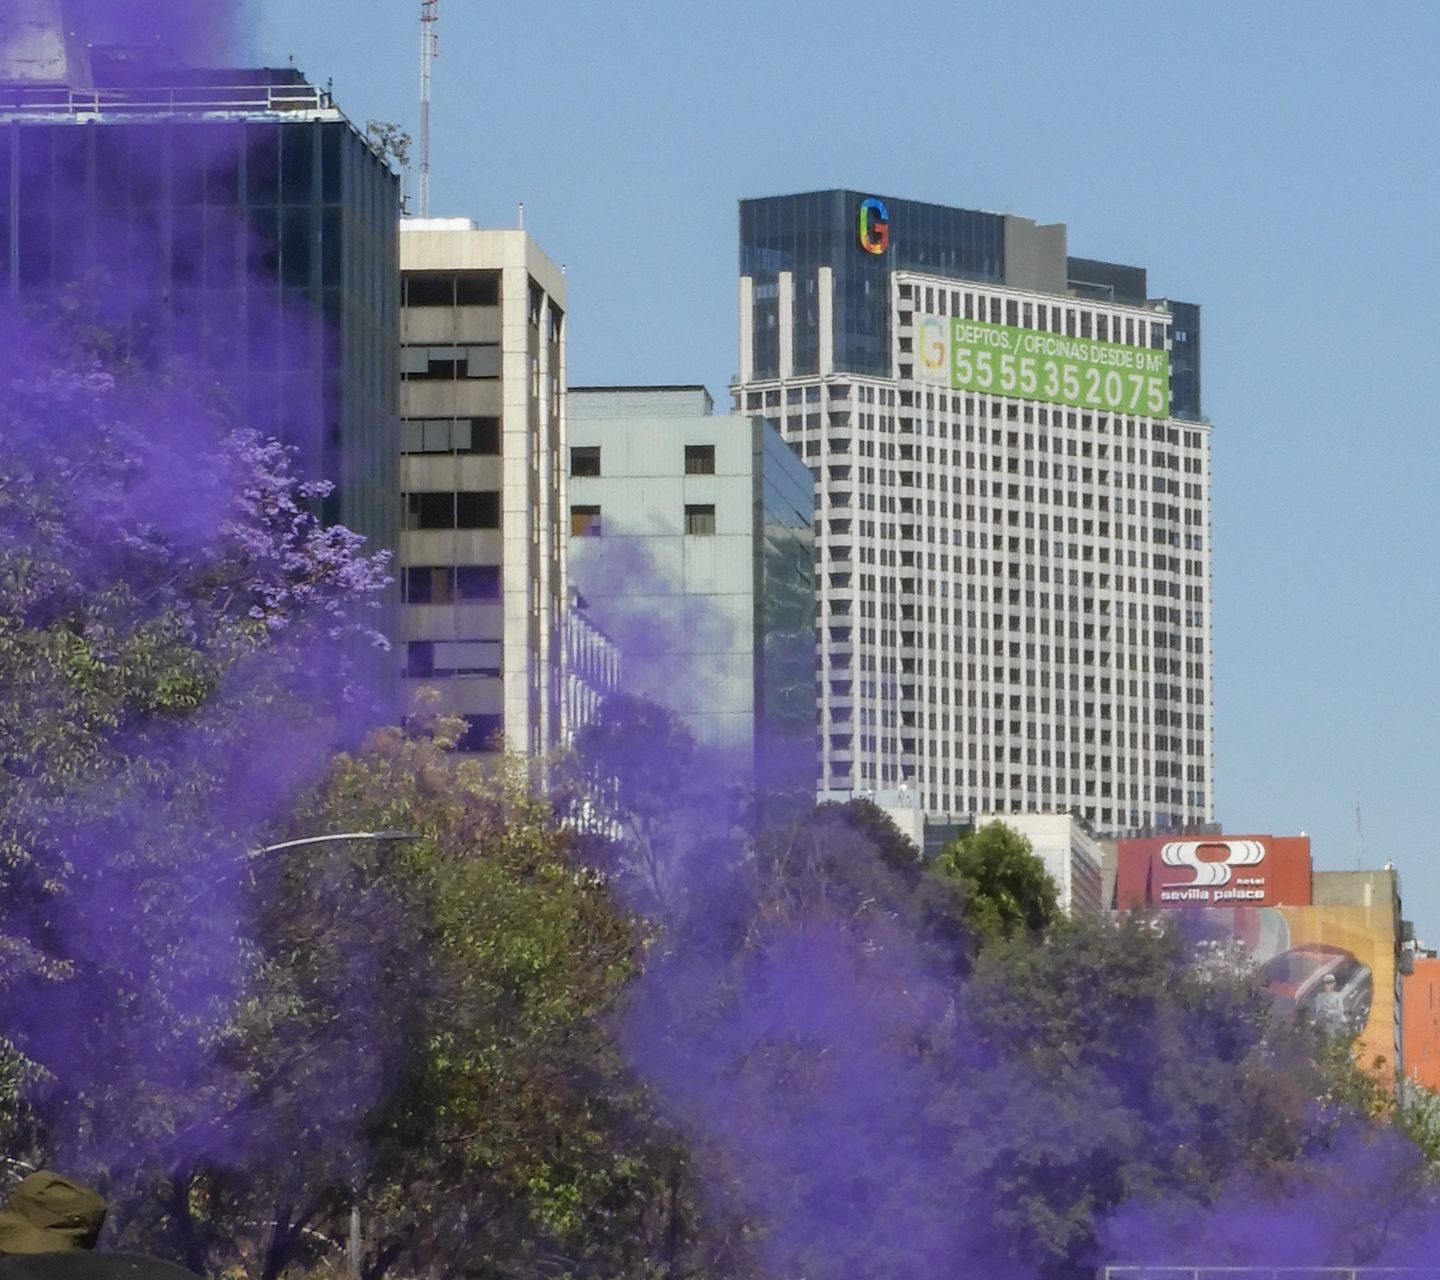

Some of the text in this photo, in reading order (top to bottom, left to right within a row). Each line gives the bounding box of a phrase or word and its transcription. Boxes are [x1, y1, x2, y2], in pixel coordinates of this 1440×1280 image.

[956, 324, 1012, 349] DEPTOS.
[1024, 335, 1088, 361] OFICINAS
[1091, 346, 1133, 368] DESDE
[1136, 354, 1144, 369] 9
[1237, 877, 1264, 885] hotel
[1161, 889, 1265, 903] sevilla palace
